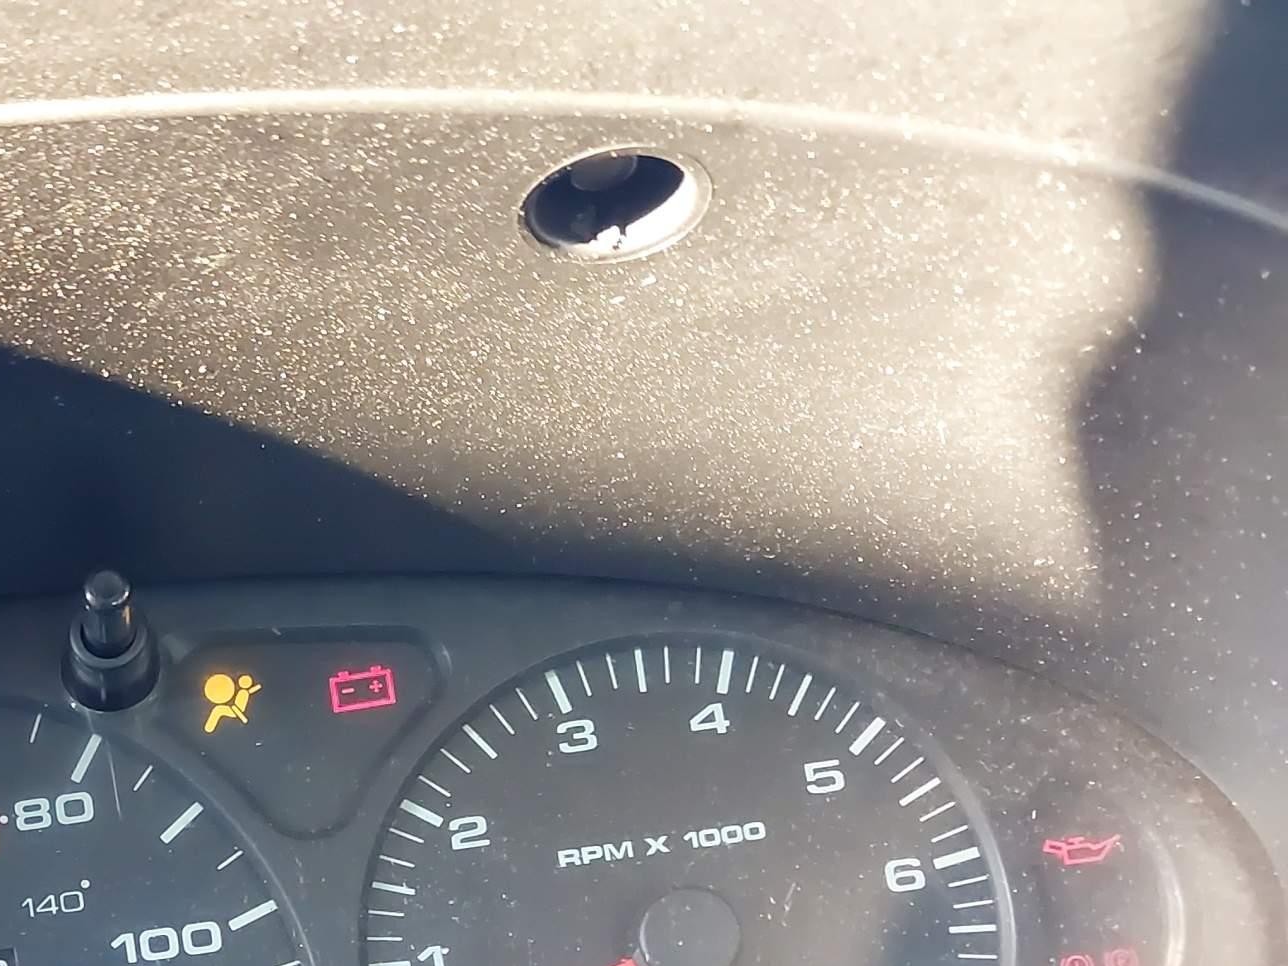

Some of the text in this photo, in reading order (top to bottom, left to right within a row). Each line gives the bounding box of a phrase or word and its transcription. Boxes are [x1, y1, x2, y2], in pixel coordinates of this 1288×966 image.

[689, 702, 731, 734] 4
[556, 719, 599, 754] 3
[804, 759, 846, 794] 5
[14, 791, 94, 831] 80
[448, 815, 491, 850] 2
[557, 840, 634, 868] RPM
[683, 821, 767, 849] 1000
[884, 858, 926, 893] 6
[22, 891, 85, 918] 140
[111, 921, 222, 964] 100
